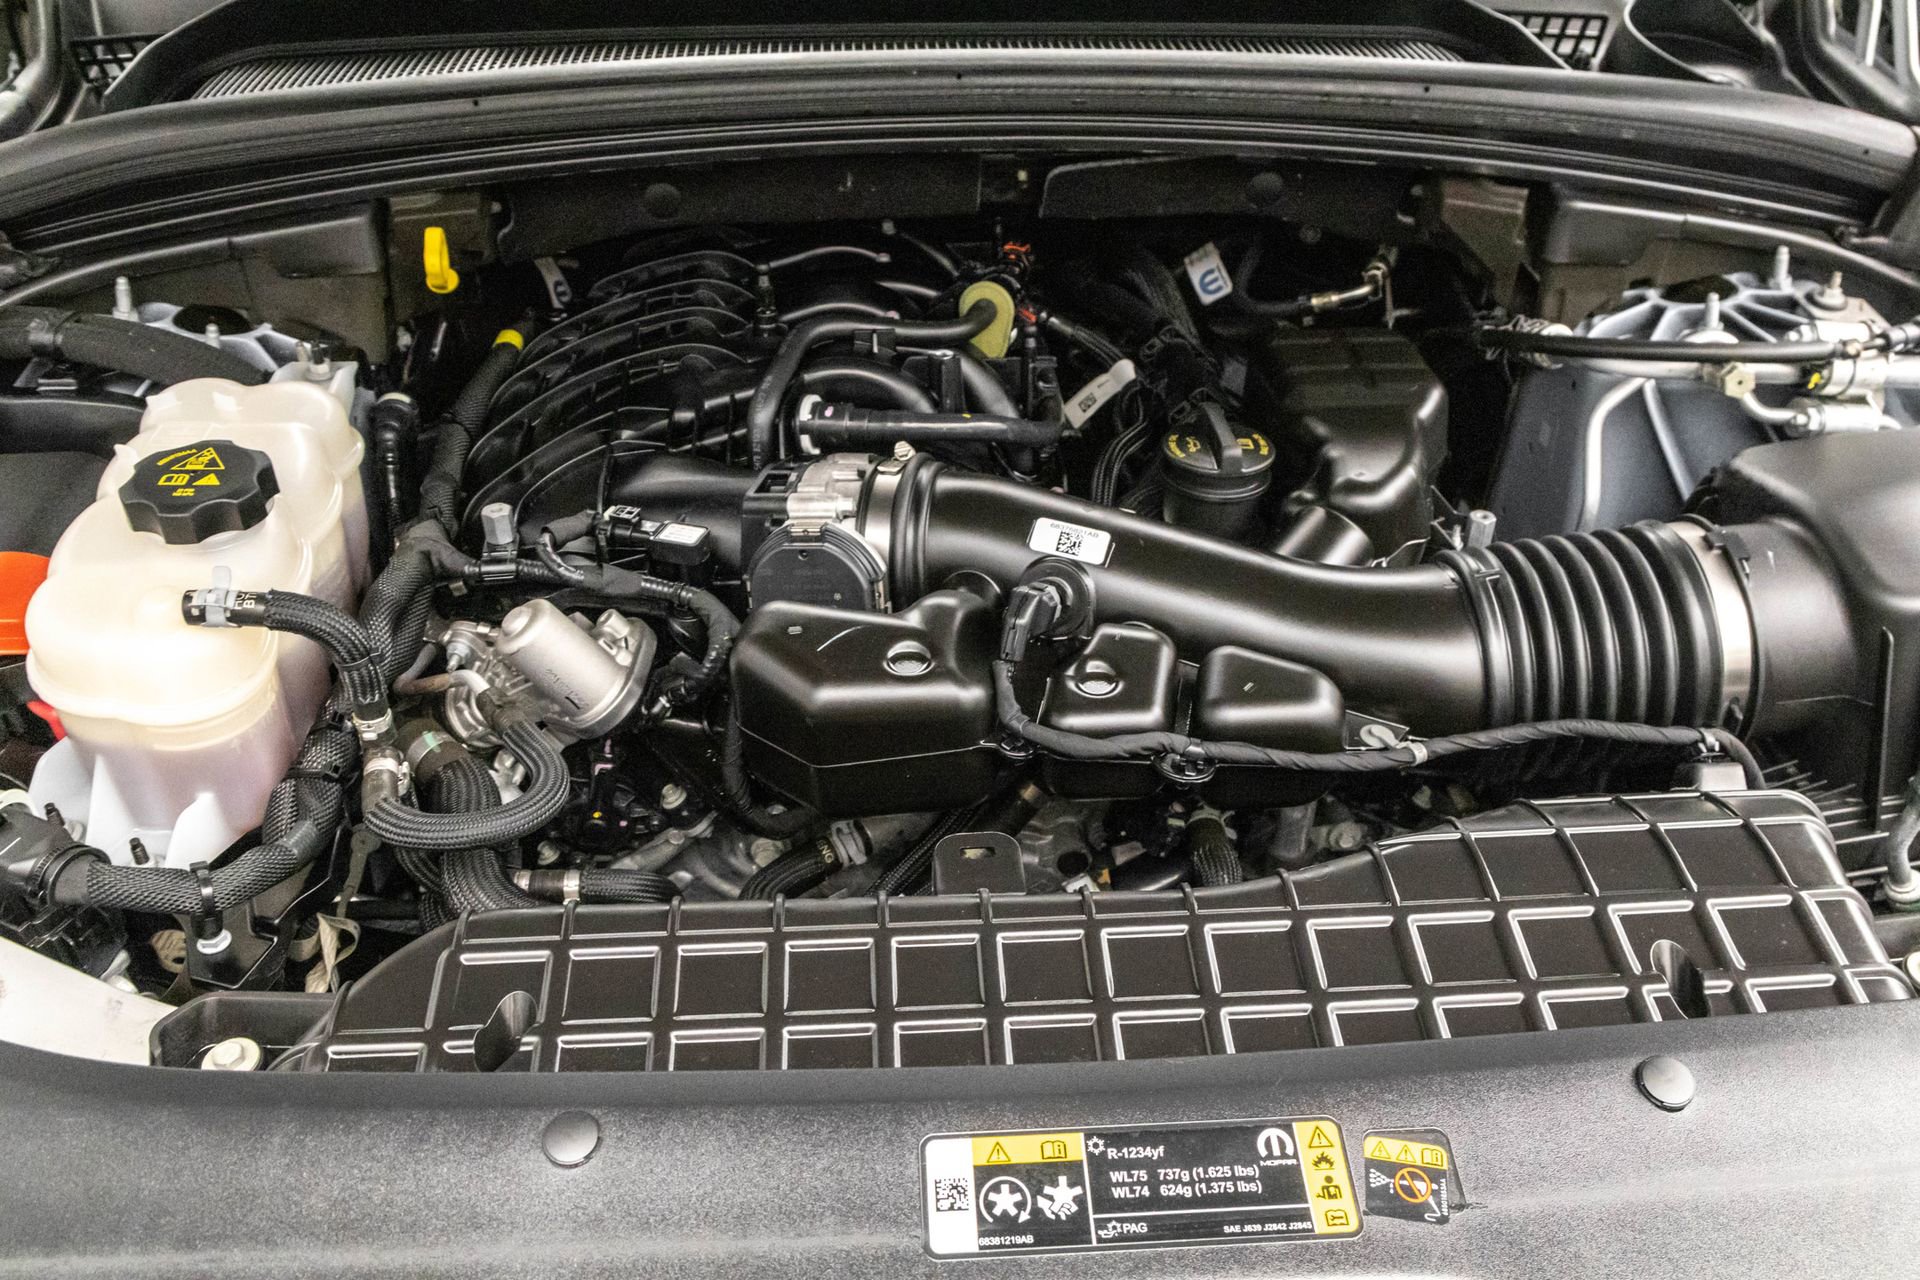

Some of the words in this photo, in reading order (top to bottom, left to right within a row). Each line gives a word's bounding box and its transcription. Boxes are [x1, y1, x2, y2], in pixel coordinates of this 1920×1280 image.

[1106, 1145, 1165, 1160] R-1234yf
[1259, 1158, 1297, 1167] MOPAR
[1109, 1169, 1149, 1183] WL75
[1157, 1167, 1190, 1182] 737g
[1192, 1165, 1232, 1181] (1.625
[1233, 1163, 1260, 1179] lbs)
[1111, 1185, 1151, 1199] WL74
[1159, 1183, 1193, 1198] 624g
[1194, 1181, 1235, 1198] (1.375
[1236, 1179, 1263, 1195] lbs)
[1122, 1222, 1149, 1235] PAG
[1223, 1224, 1242, 1234] SAE
[1242, 1223, 1263, 1233] J639
[1263, 1222, 1288, 1232] J2842
[978, 1234, 1035, 1246] 68381219AB
